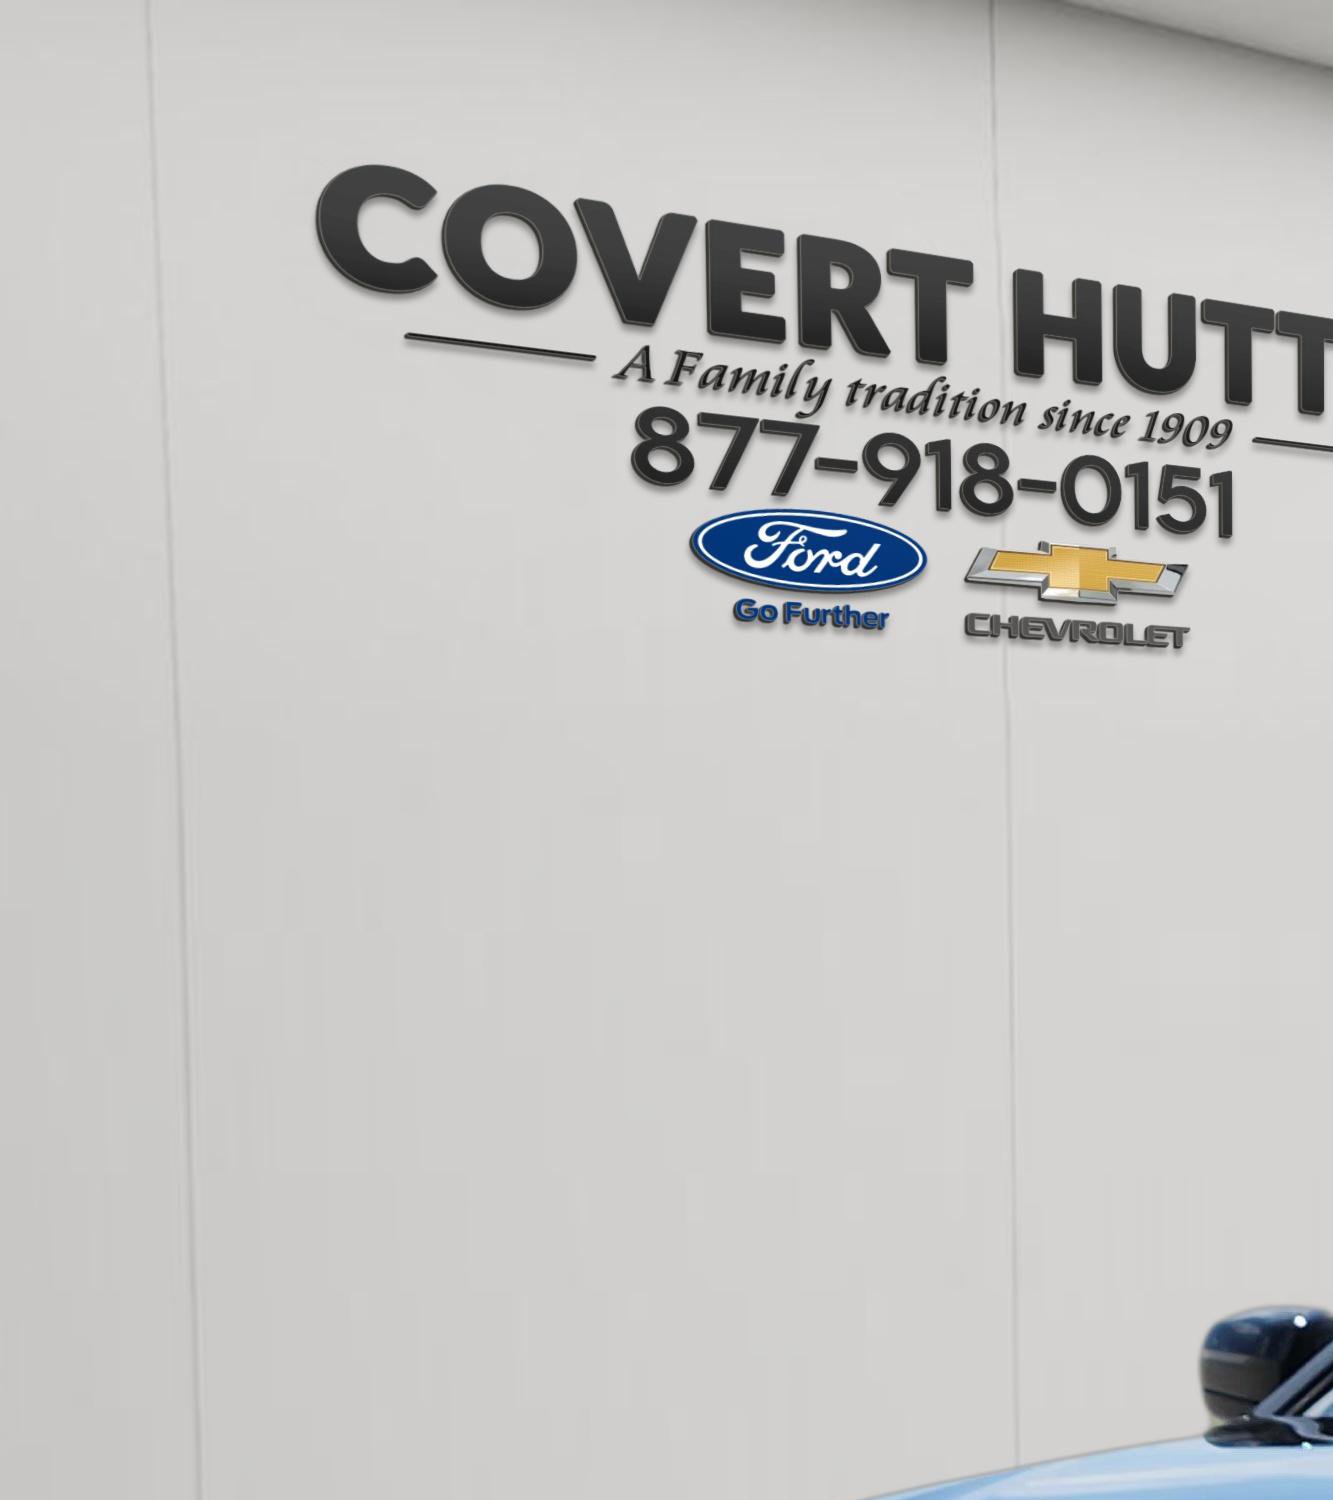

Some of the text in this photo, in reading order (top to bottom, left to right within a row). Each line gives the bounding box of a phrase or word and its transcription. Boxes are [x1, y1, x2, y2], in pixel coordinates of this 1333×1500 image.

[316, 163, 973, 365] COVERT
[612, 344, 1234, 449] A Family tradition since 1909
[629, 405, 1234, 539] 877-918-0151
[743, 519, 881, 579] Ford
[733, 597, 890, 632] Go Further
[963, 611, 1192, 650] CHEVROLET
